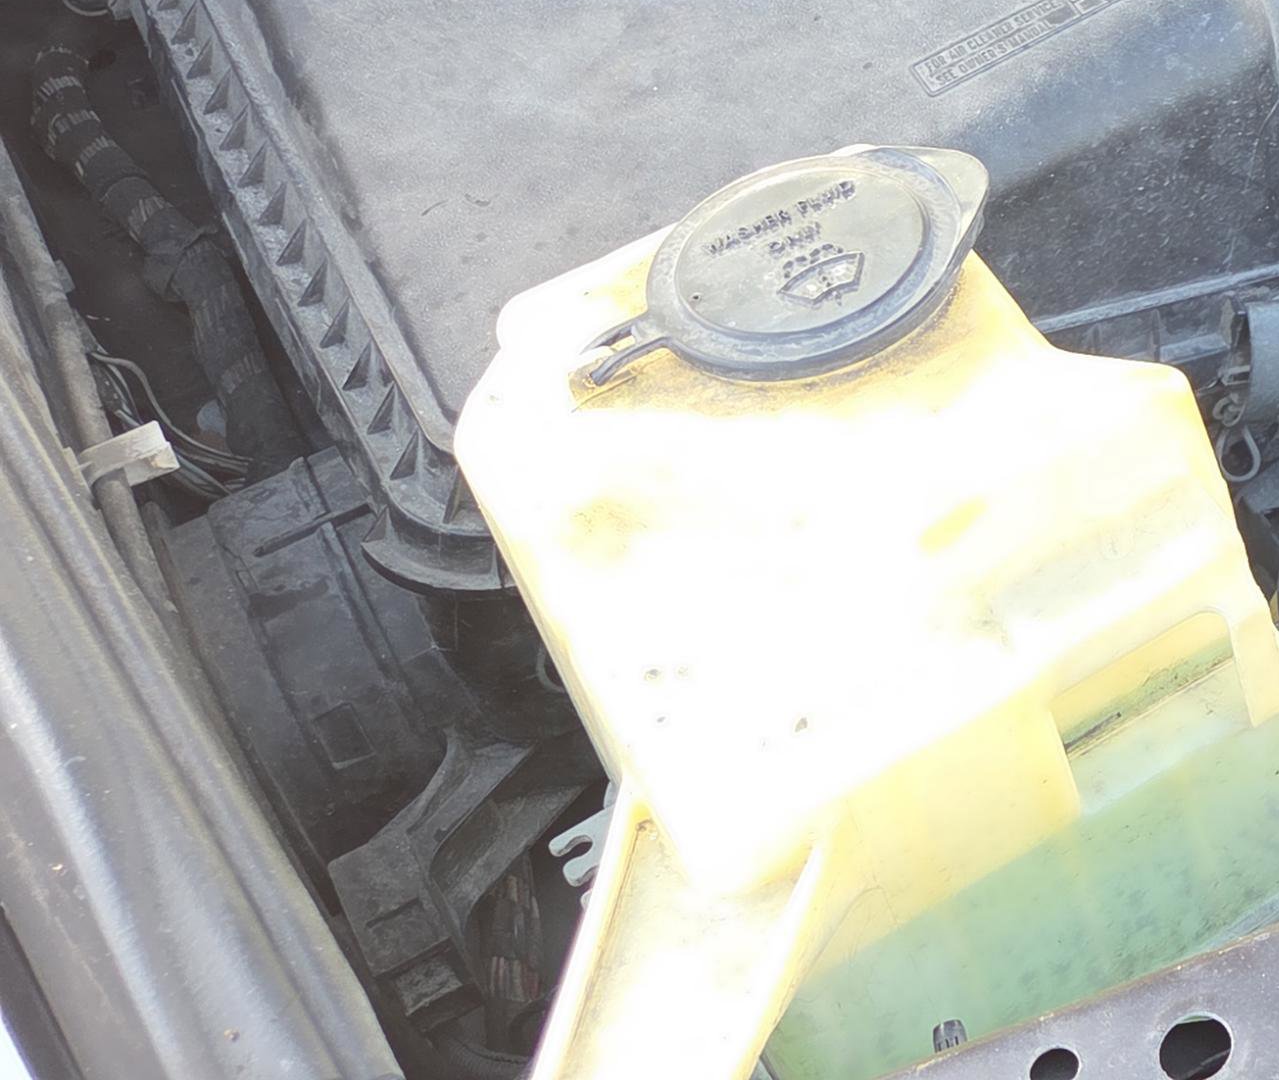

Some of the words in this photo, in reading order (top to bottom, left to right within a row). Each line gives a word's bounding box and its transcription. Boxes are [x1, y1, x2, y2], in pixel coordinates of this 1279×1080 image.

[924, 54, 947, 73] FOR
[948, 43, 968, 62] AIR
[967, 20, 1013, 51] CLEANER
[935, 66, 958, 86] SEE
[958, 42, 1007, 74] OWNER'S
